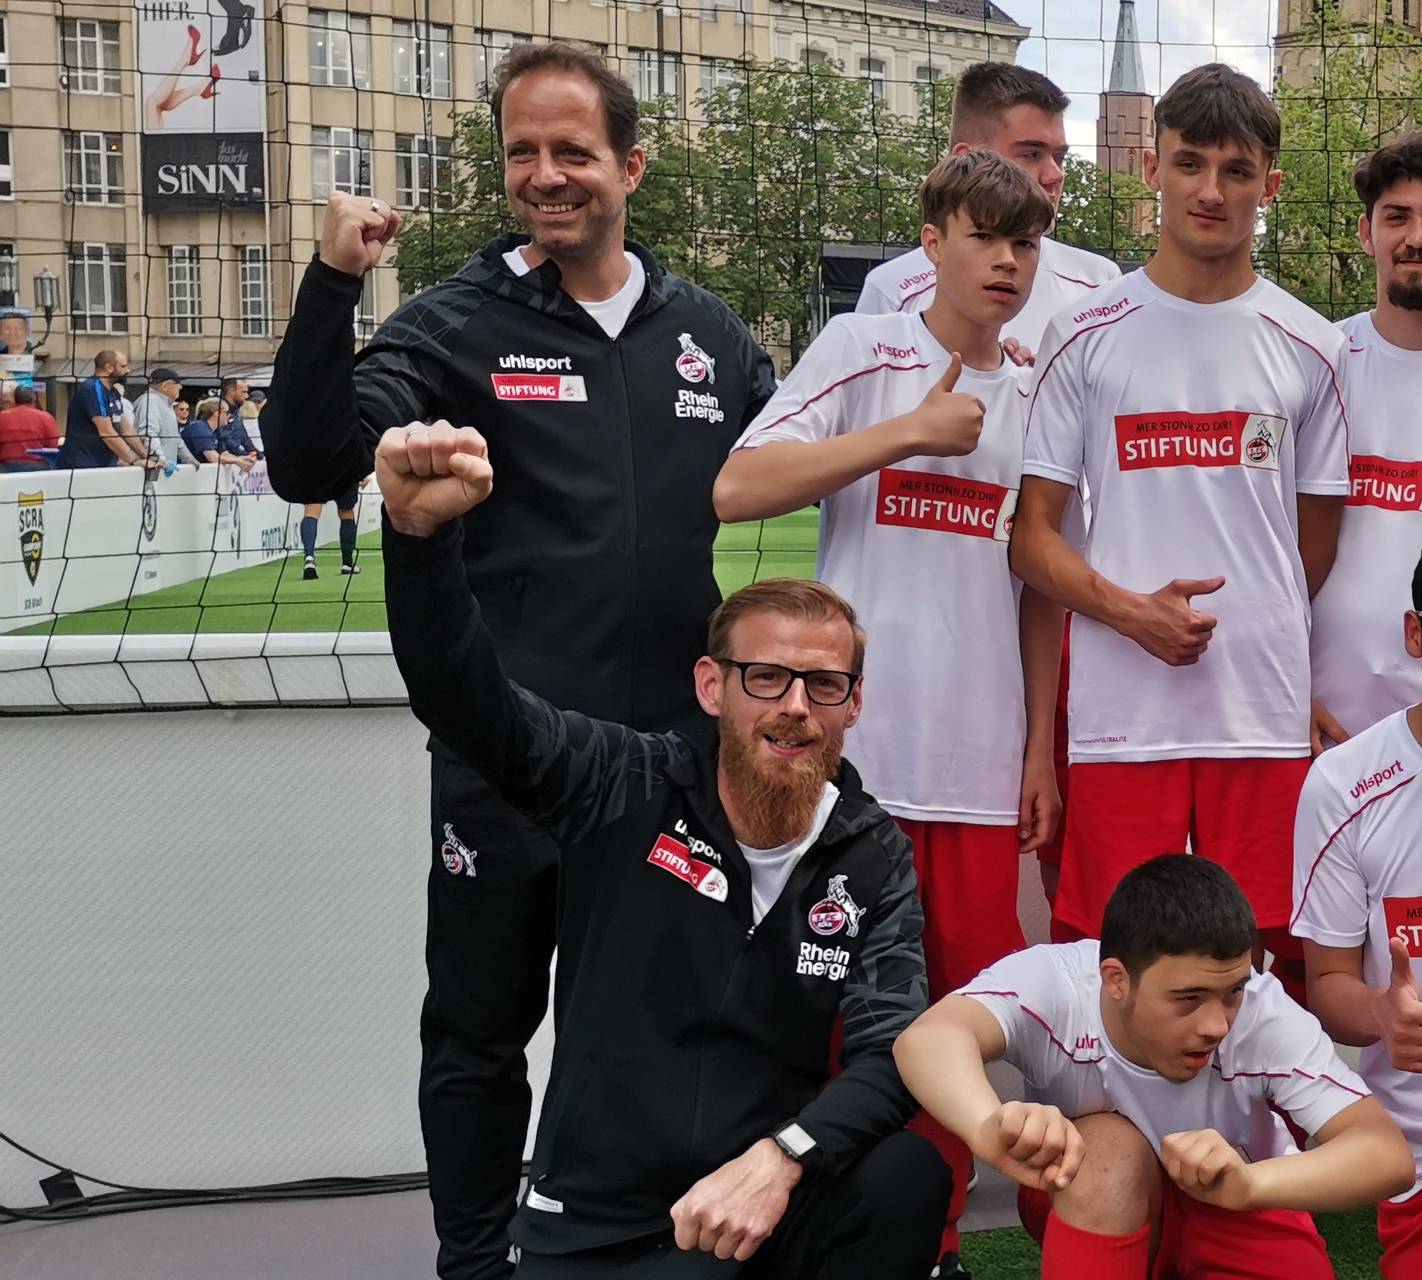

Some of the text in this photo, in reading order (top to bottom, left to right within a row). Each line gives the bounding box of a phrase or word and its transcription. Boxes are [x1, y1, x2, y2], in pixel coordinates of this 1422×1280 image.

[1073, 297, 1130, 324] uhlsport
[499, 354, 573, 372] uhlsport
[499, 385, 556, 396] STIFTUNG
[677, 389, 719, 409] Rhein
[674, 402, 725, 424] Energie
[1136, 422, 1158, 433] MER
[1124, 435, 1235, 460] STIFTUNG
[19, 508, 45, 533] SCRA
[884, 494, 996, 529] STIFTUNG
[1350, 760, 1404, 799] uhlsport
[800, 942, 850, 966] Rhein
[796, 955, 850, 981] Energi
